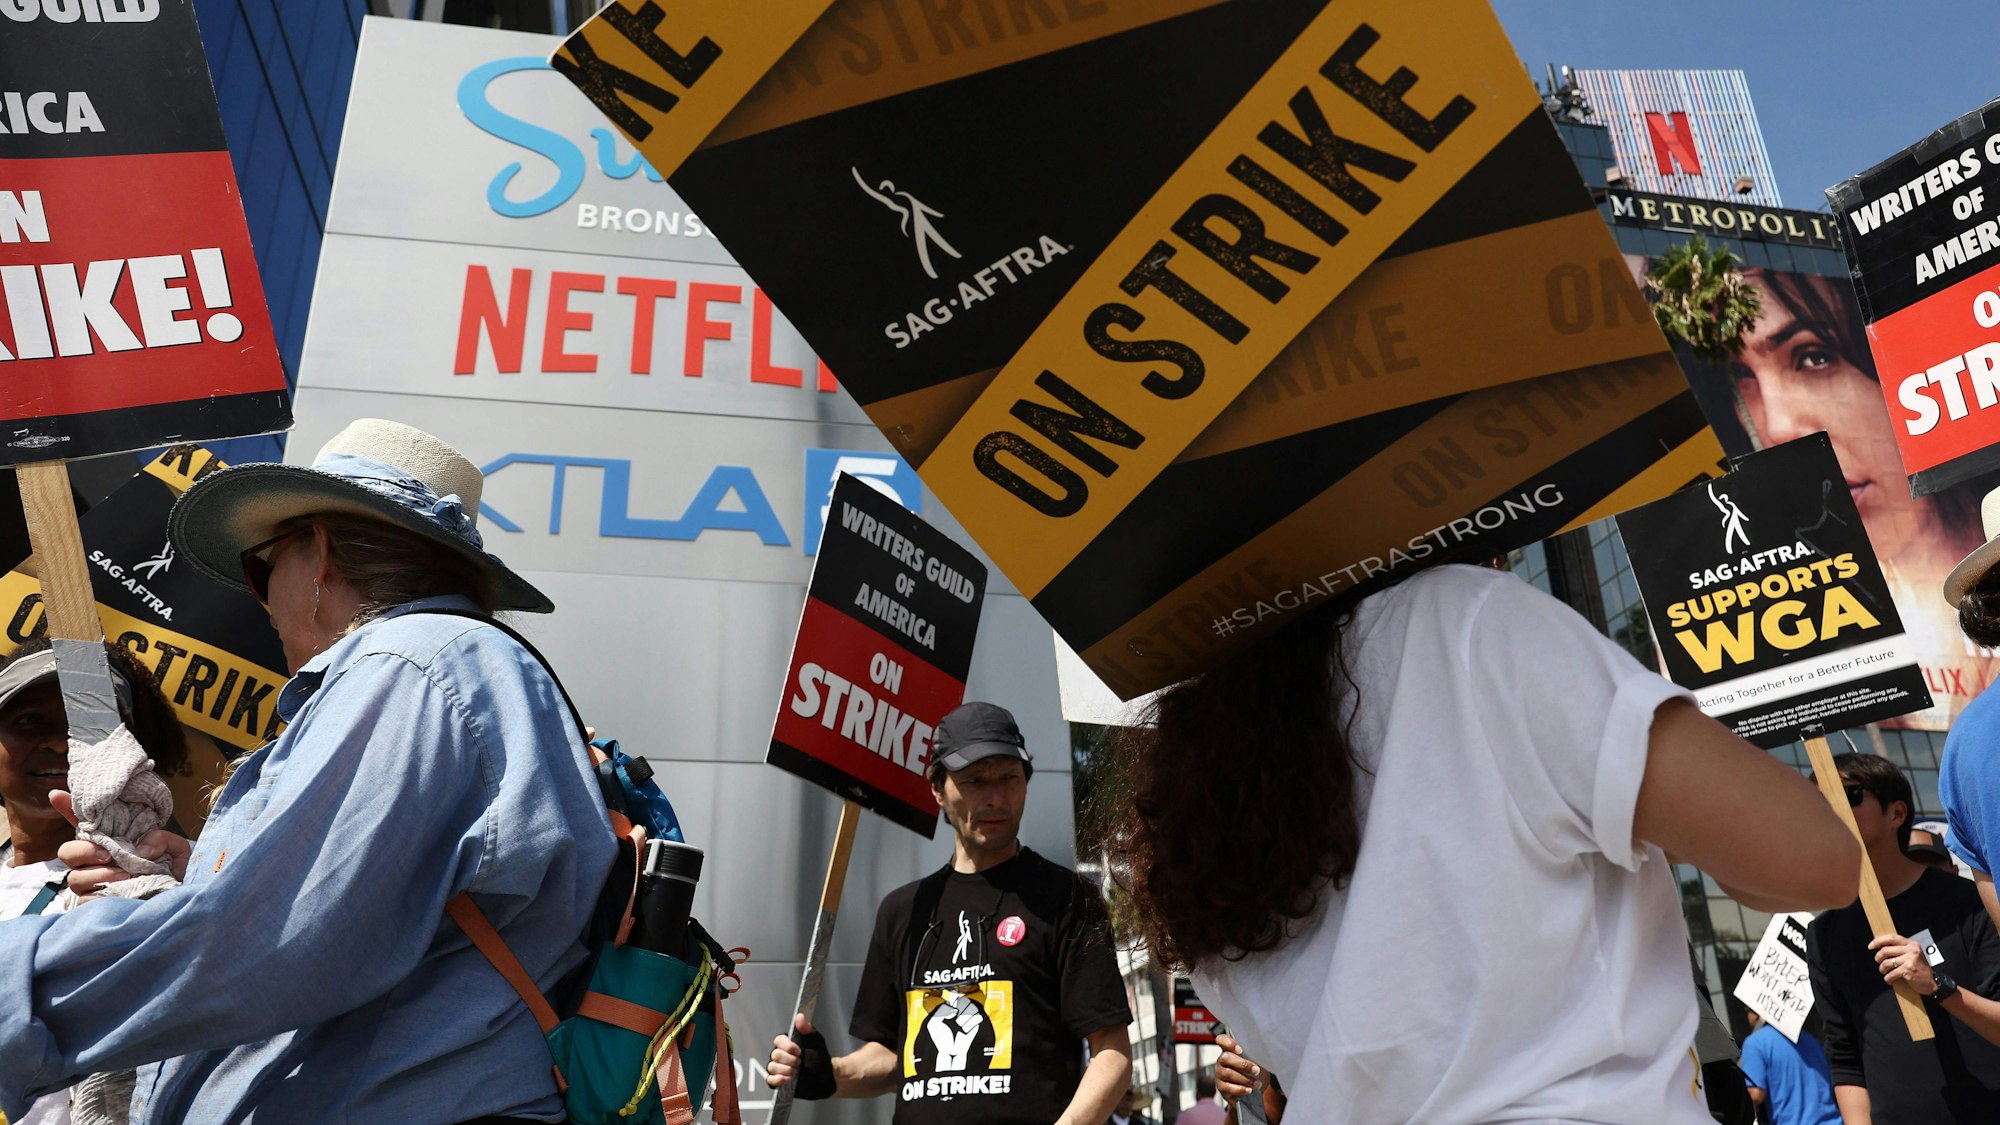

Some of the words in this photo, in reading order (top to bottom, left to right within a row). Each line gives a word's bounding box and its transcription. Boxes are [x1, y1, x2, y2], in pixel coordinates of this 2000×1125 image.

[1850, 147, 1982, 236] WRITERS
[1952, 186, 1985, 221] OF
[973, 369, 1146, 518] ON
[1083, 22, 1477, 401] STRIKE
[1915, 213, 2000, 286] AMER
[0, 247, 243, 362] IKE!
[841, 501, 925, 573] WRITERS
[925, 556, 976, 605] GUILD
[895, 573, 916, 599] OF
[1211, 483, 1565, 639] #SAGAFTRASTRONG
[1666, 552, 1860, 628] SUPPORTS
[854, 582, 937, 651] AMERICA
[1674, 585, 1882, 674] WGA
[869, 652, 904, 695] ON
[1698, 692, 1735, 710] Acting
[1736, 680, 1787, 701] Together
[1789, 671, 1805, 685] for
[1808, 672, 1815, 680] a
[1816, 660, 1853, 678] Better
[1855, 649, 1895, 667] Future
[902, 1079, 925, 1102] ON
[926, 1074, 1011, 1097] STRIKE!
